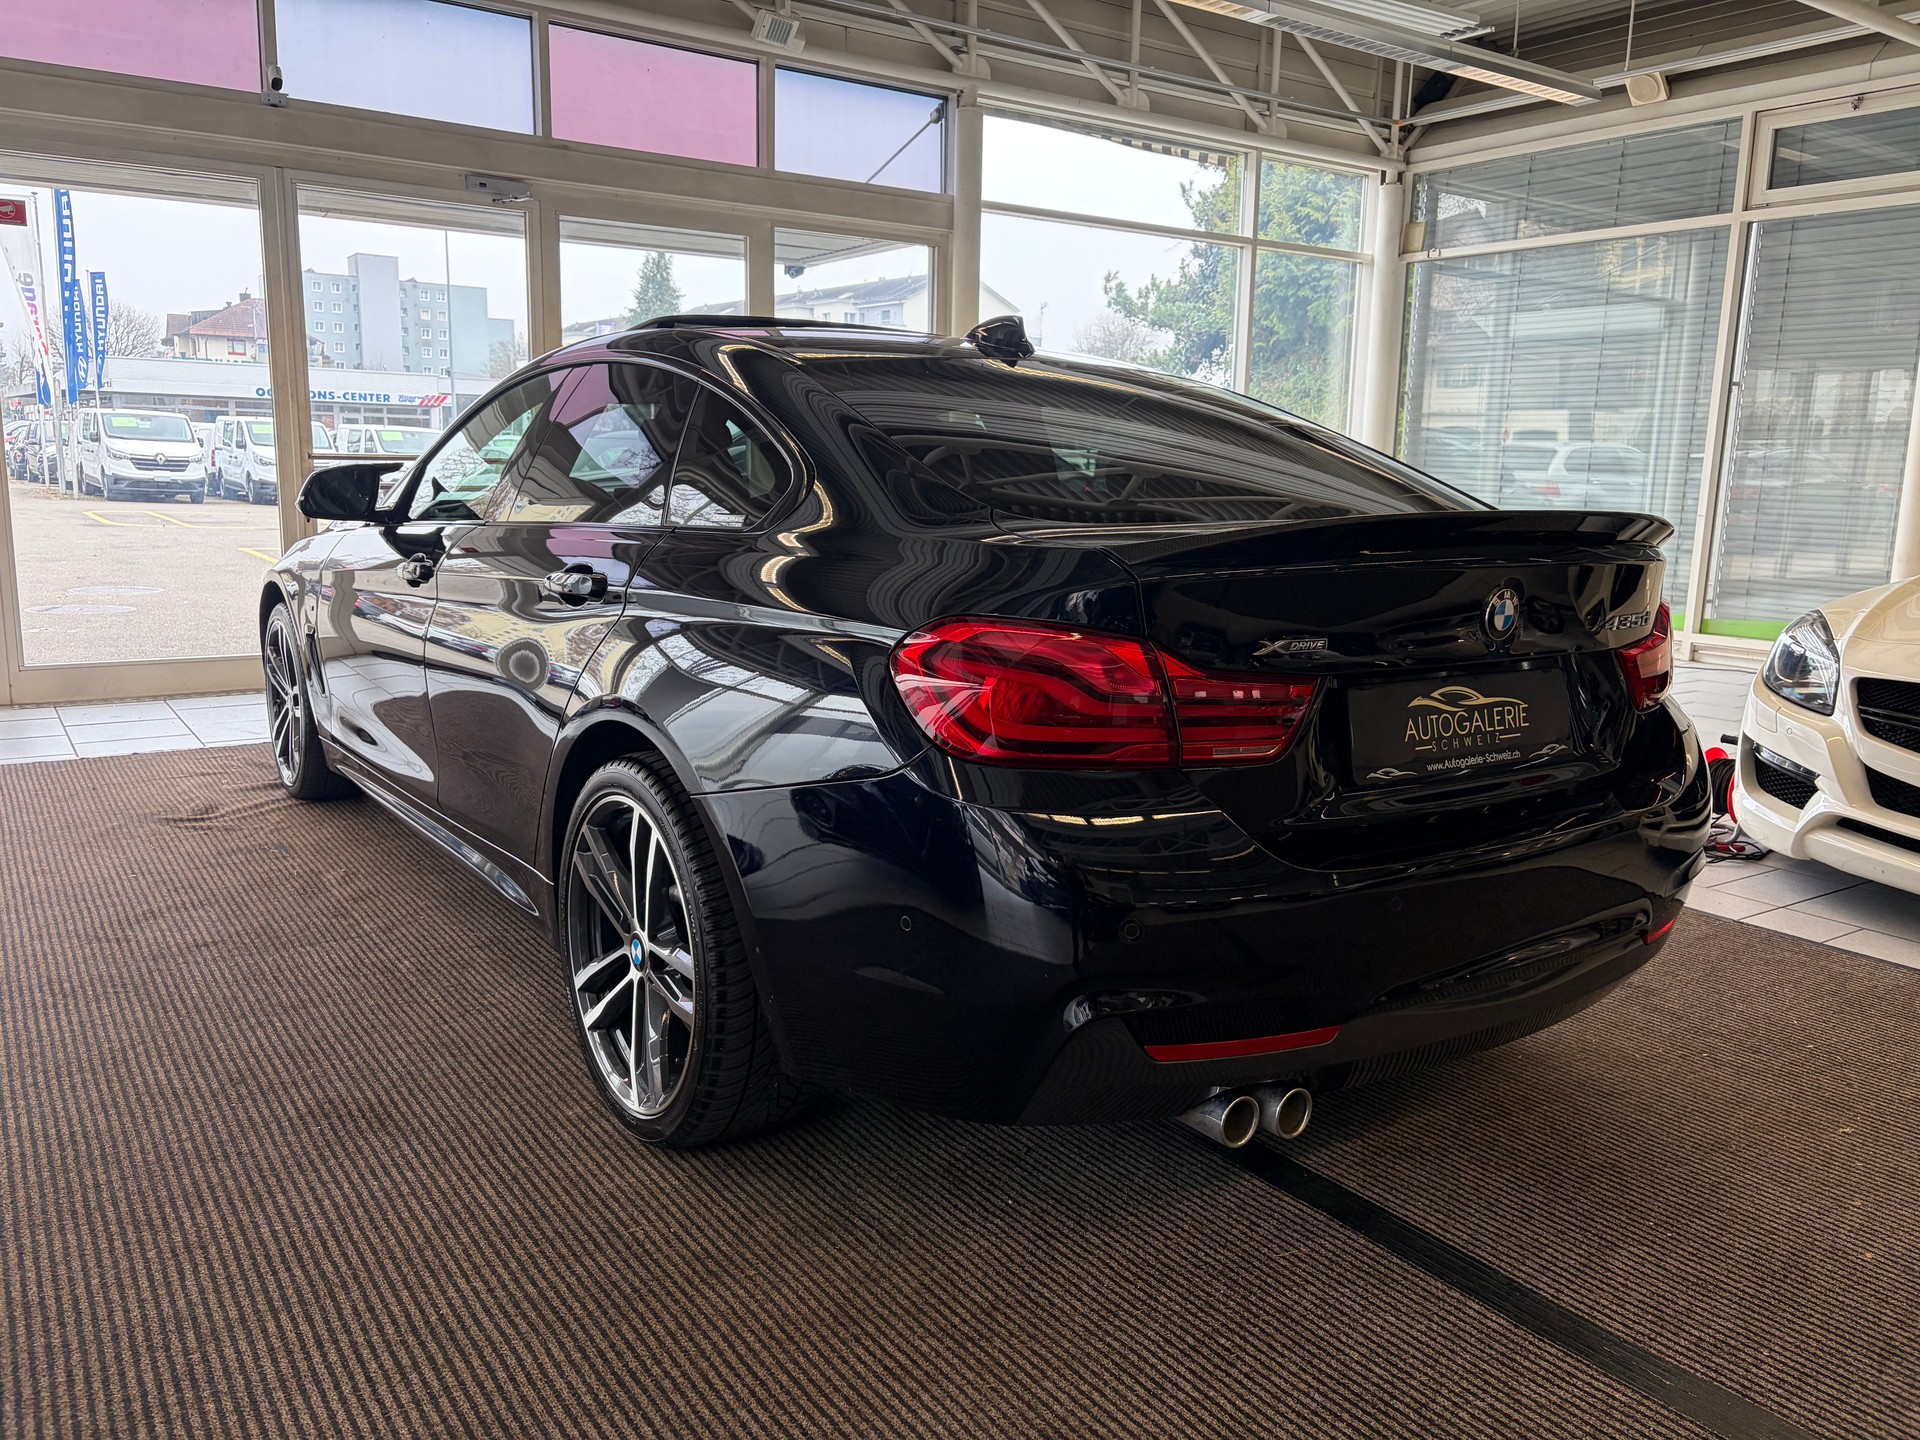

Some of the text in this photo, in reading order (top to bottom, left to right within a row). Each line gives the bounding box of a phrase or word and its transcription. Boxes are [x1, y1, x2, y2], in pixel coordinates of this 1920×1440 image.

[95, 279, 106, 351] HYUNDAI
[1604, 611, 1651, 631] 435d
[1404, 704, 1530, 742] AUTOGALERIE
[1431, 732, 1501, 752] SCHWEIZ
[1426, 749, 1521, 772] www.Autogalerie-Schweiz.ch
